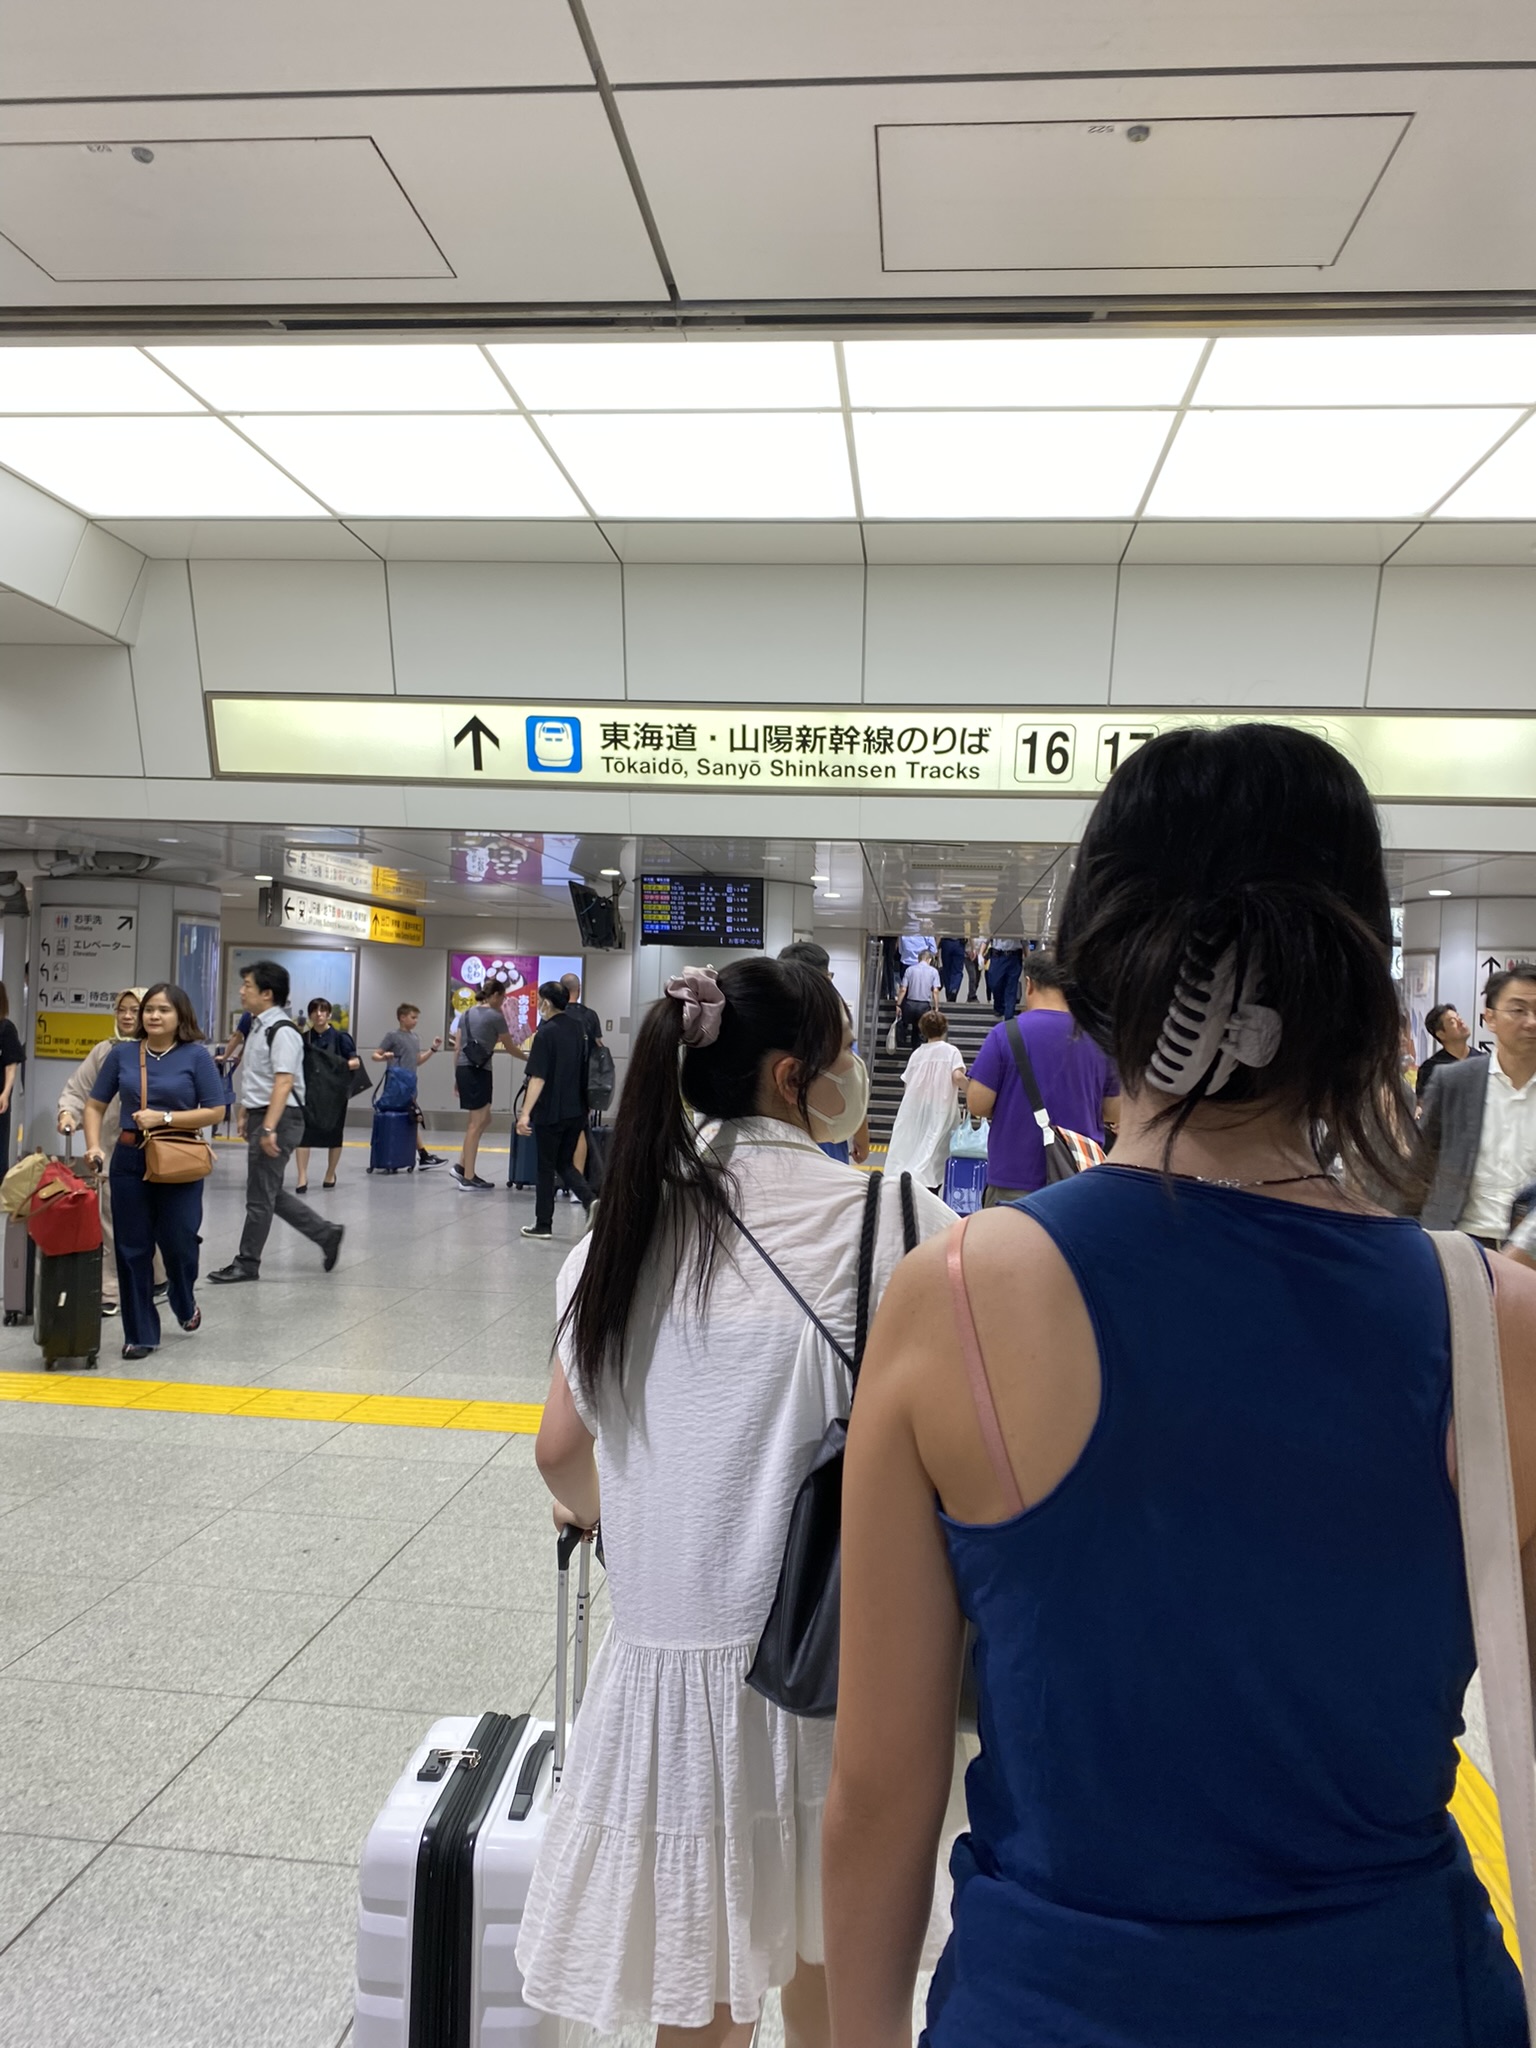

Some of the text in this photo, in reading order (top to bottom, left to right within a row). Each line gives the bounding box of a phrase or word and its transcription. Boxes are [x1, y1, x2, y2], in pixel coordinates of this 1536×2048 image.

[600, 722, 991, 755] 東海道・山陽新幹線のりば
[1022, 731, 1070, 775] 16
[601, 757, 980, 779] Tōkaidō, Sanyō Shinkansen Tracks
[74, 914, 103, 925] お手洗
[73, 940, 131, 951] エレベーター
